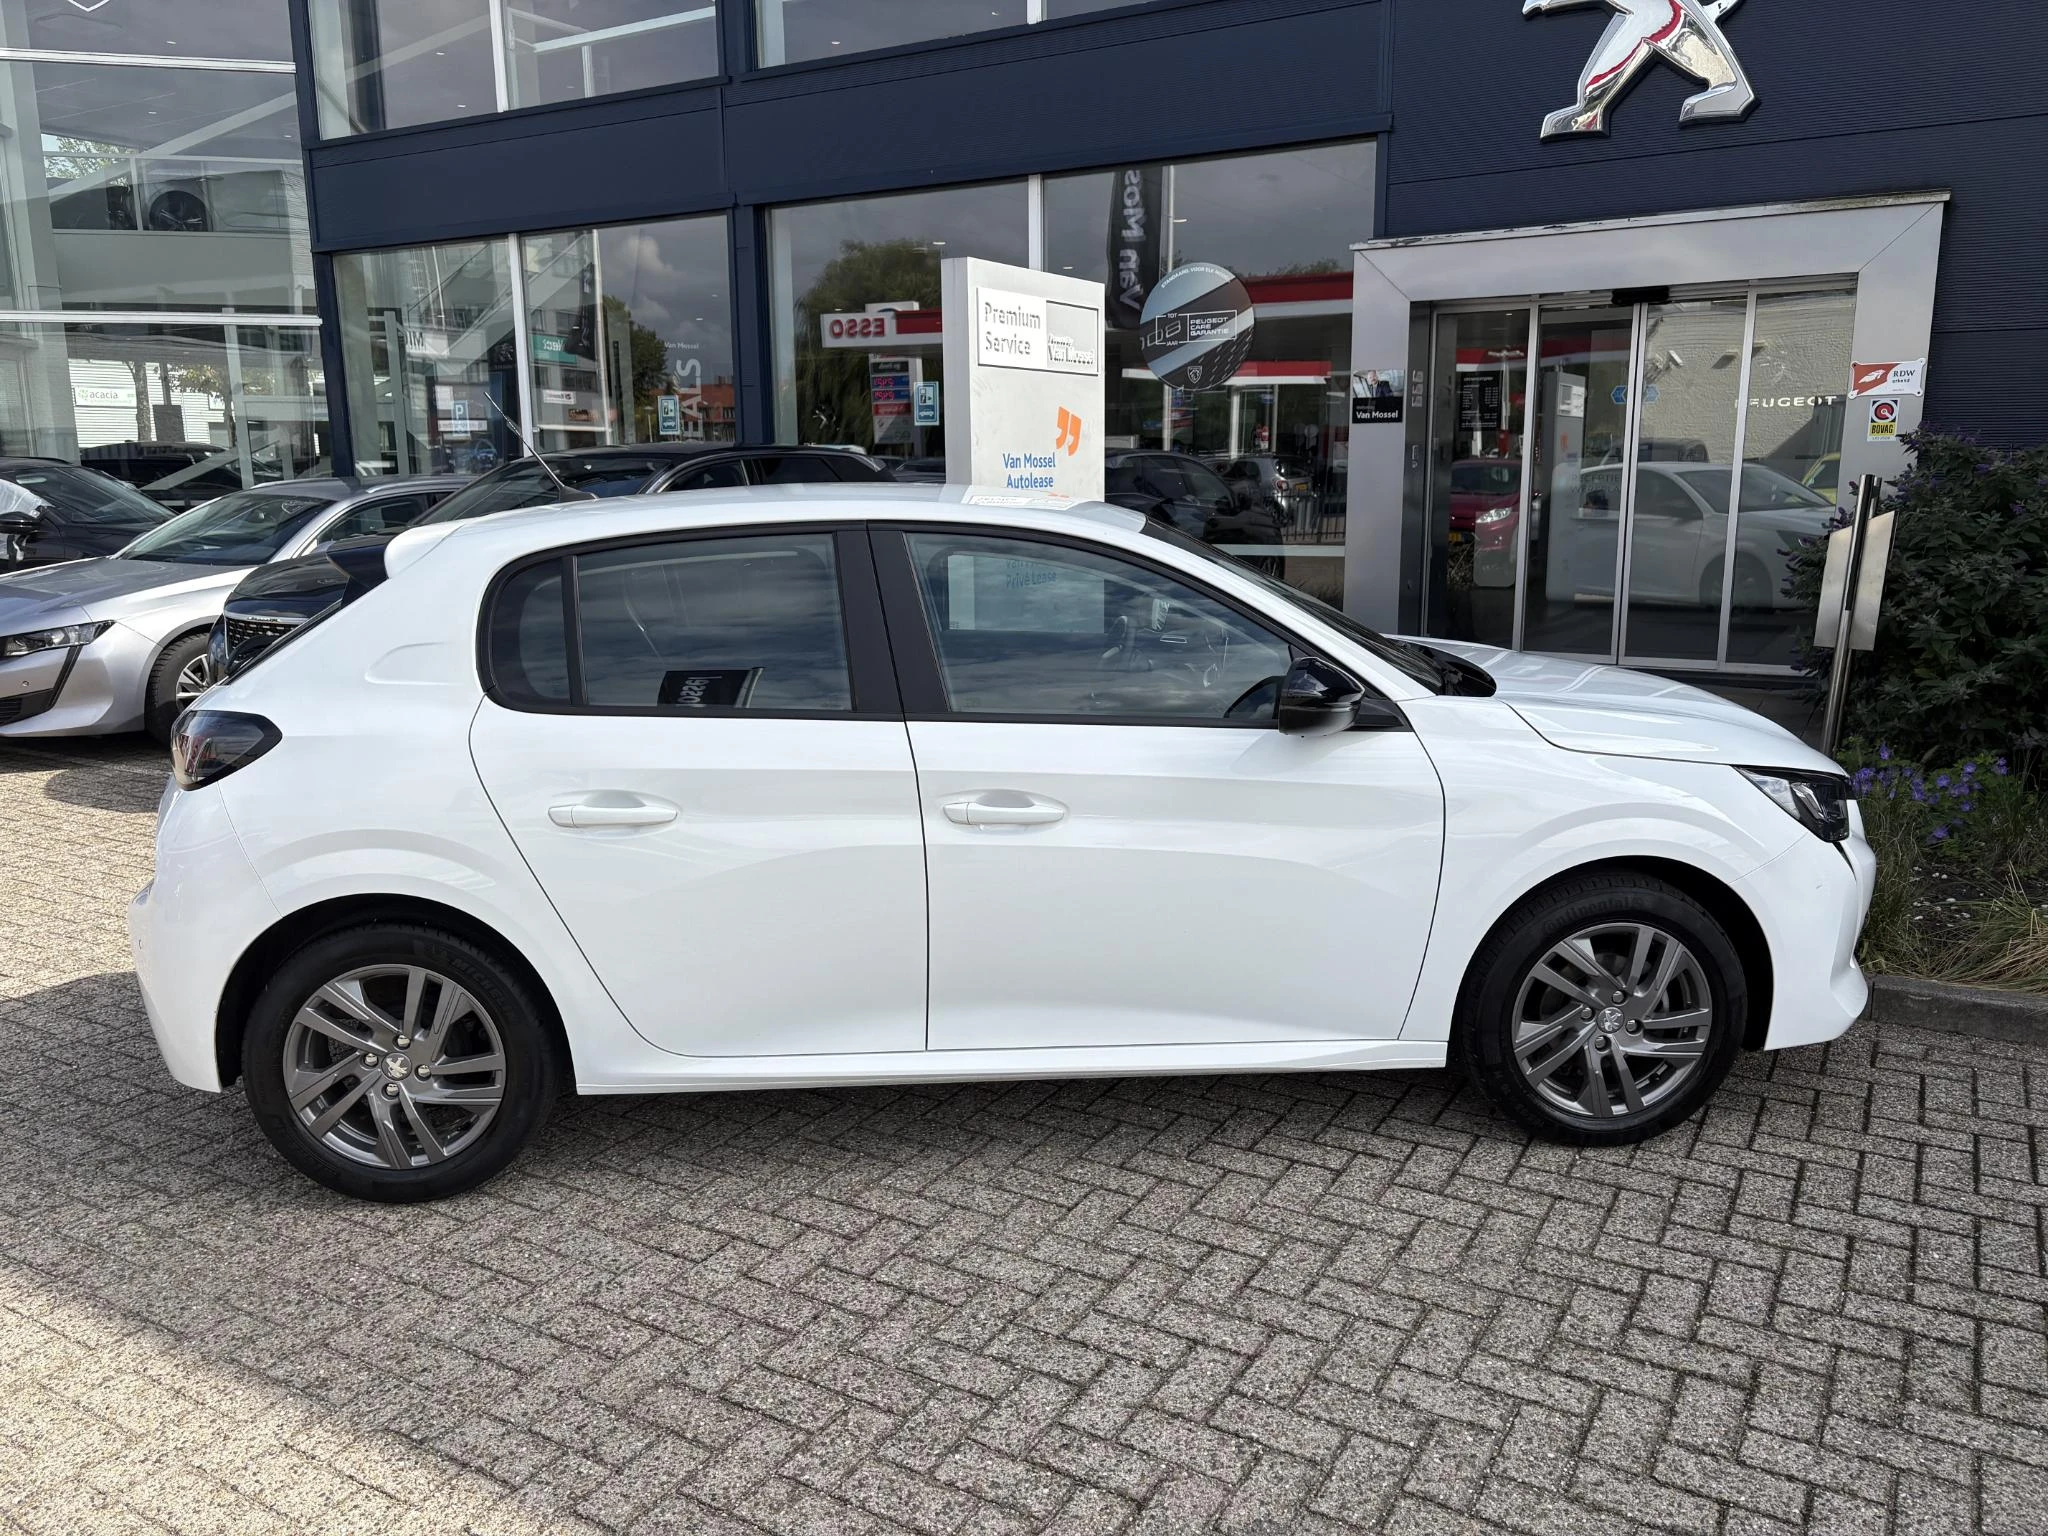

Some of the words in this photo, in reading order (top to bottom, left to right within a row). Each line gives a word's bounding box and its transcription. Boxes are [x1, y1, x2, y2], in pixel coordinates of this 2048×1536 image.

[984, 301, 1041, 330] Premium
[1190, 316, 1229, 325] PEUGEOT
[1190, 323, 1212, 331] CARE
[1190, 328, 1230, 337] GARANTIE
[985, 331, 1032, 356] Service
[1893, 369, 1916, 378] RDW
[89, 391, 119, 400] acacia
[676, 358, 704, 442] EALS
[1356, 411, 1370, 419] Van
[1371, 410, 1399, 419] Mossel
[1871, 424, 1894, 434] BOVAG
[1003, 453, 1021, 469] Van
[1023, 452, 1056, 469] Mossel
[1006, 472, 1054, 489] Autolease
